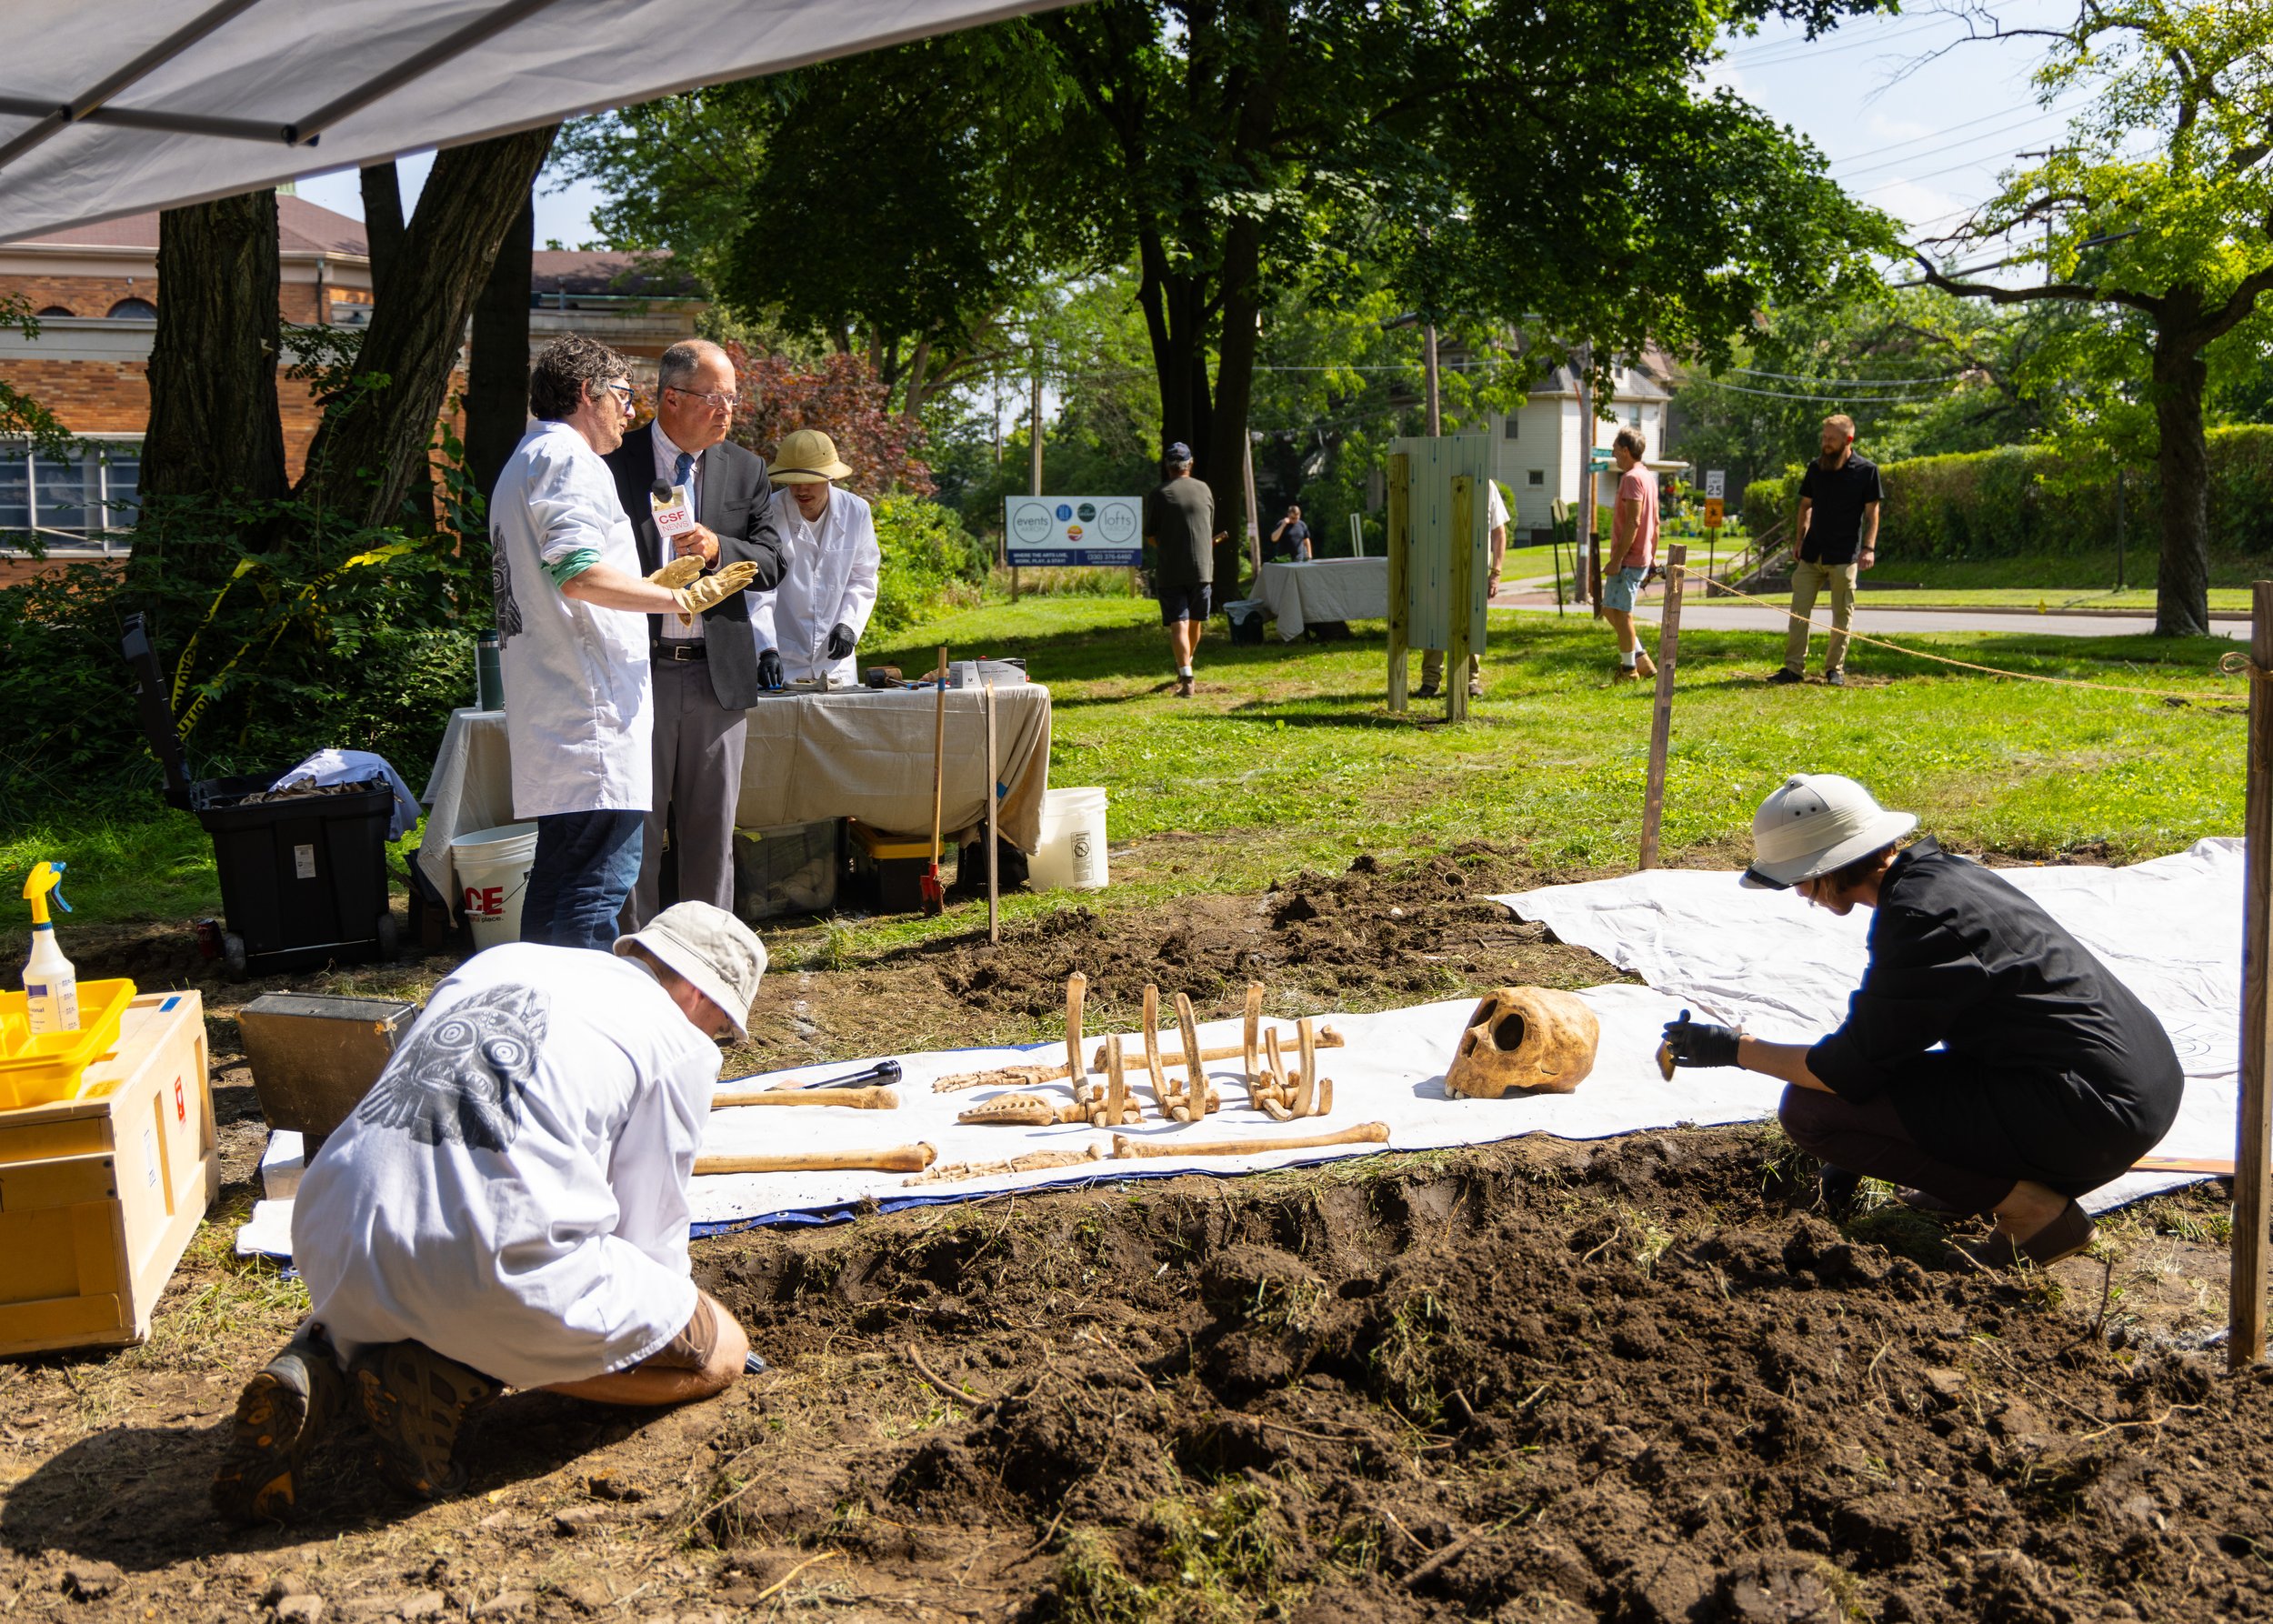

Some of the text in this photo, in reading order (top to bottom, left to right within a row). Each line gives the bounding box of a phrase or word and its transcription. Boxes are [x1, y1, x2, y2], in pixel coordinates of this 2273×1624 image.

[1707, 486, 1723, 496] 25
[659, 511, 685, 525] CSF
[1017, 516, 1048, 526] events
[1105, 512, 1131, 526] lofts
[662, 521, 689, 531] NEWS
[174, 651, 195, 712] CAUTIO
[466, 887, 503, 915] CE
